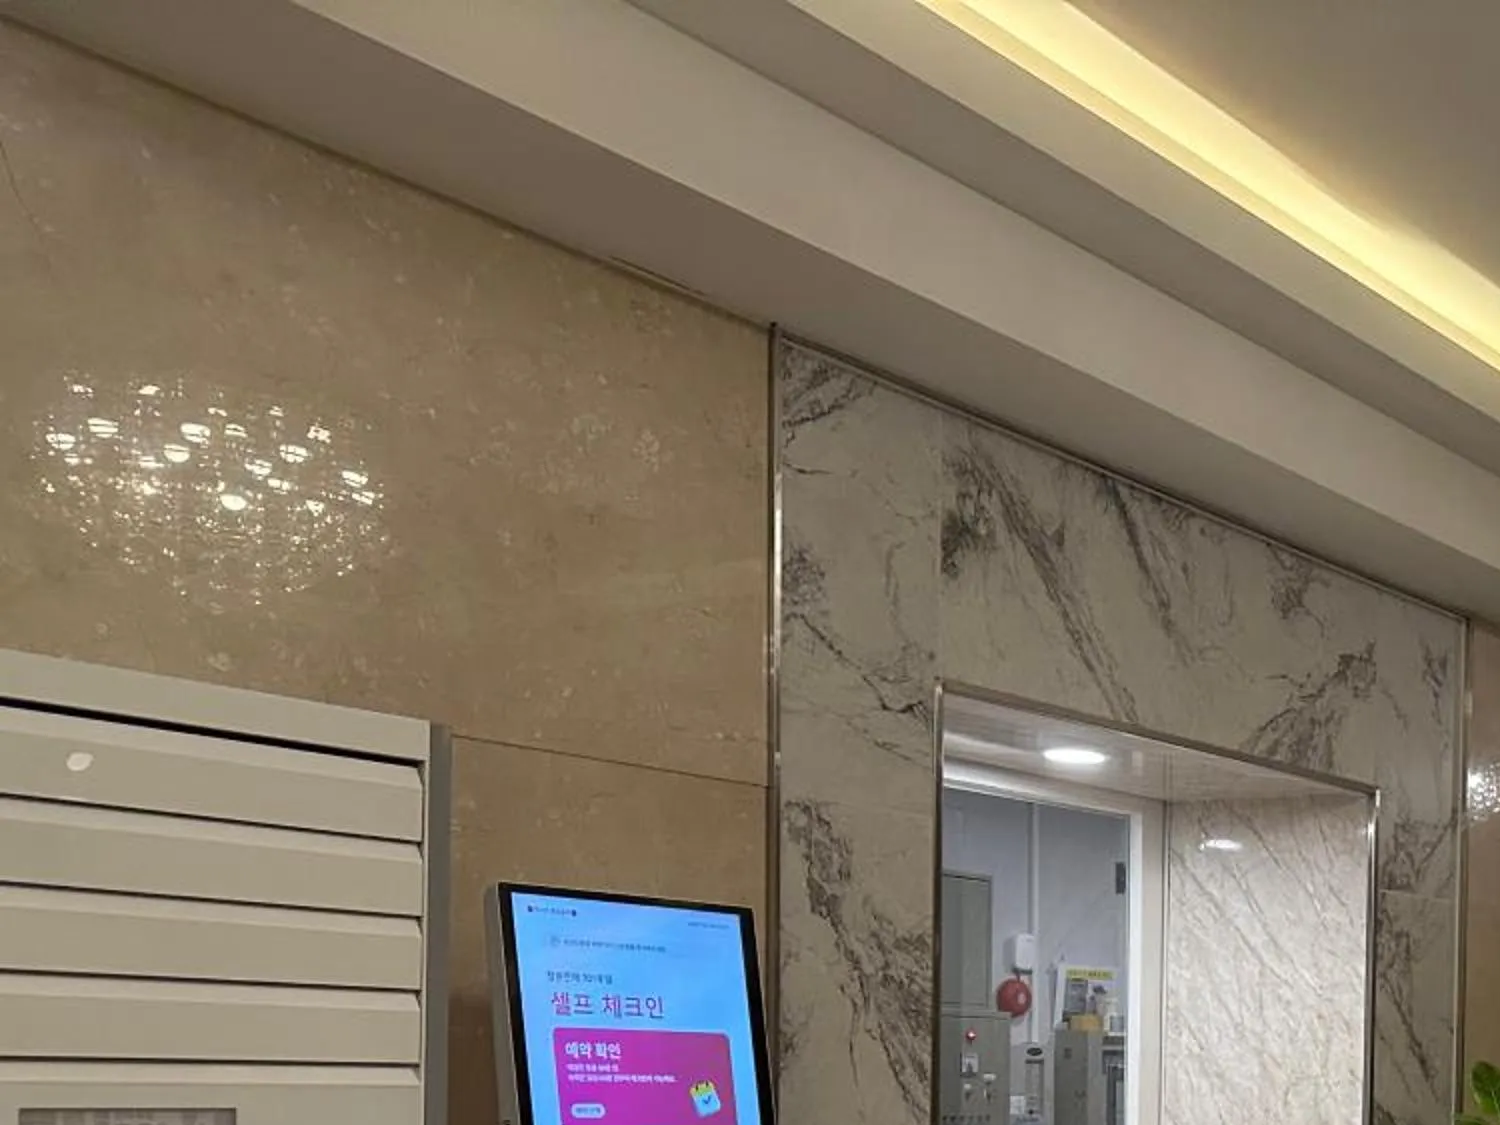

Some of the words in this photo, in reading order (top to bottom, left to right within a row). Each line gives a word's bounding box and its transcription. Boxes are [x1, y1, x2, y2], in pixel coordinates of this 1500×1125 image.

[551, 991, 593, 1016] 셀프
[601, 993, 665, 1019] 체크인
[565, 1041, 592, 1059] 예약
